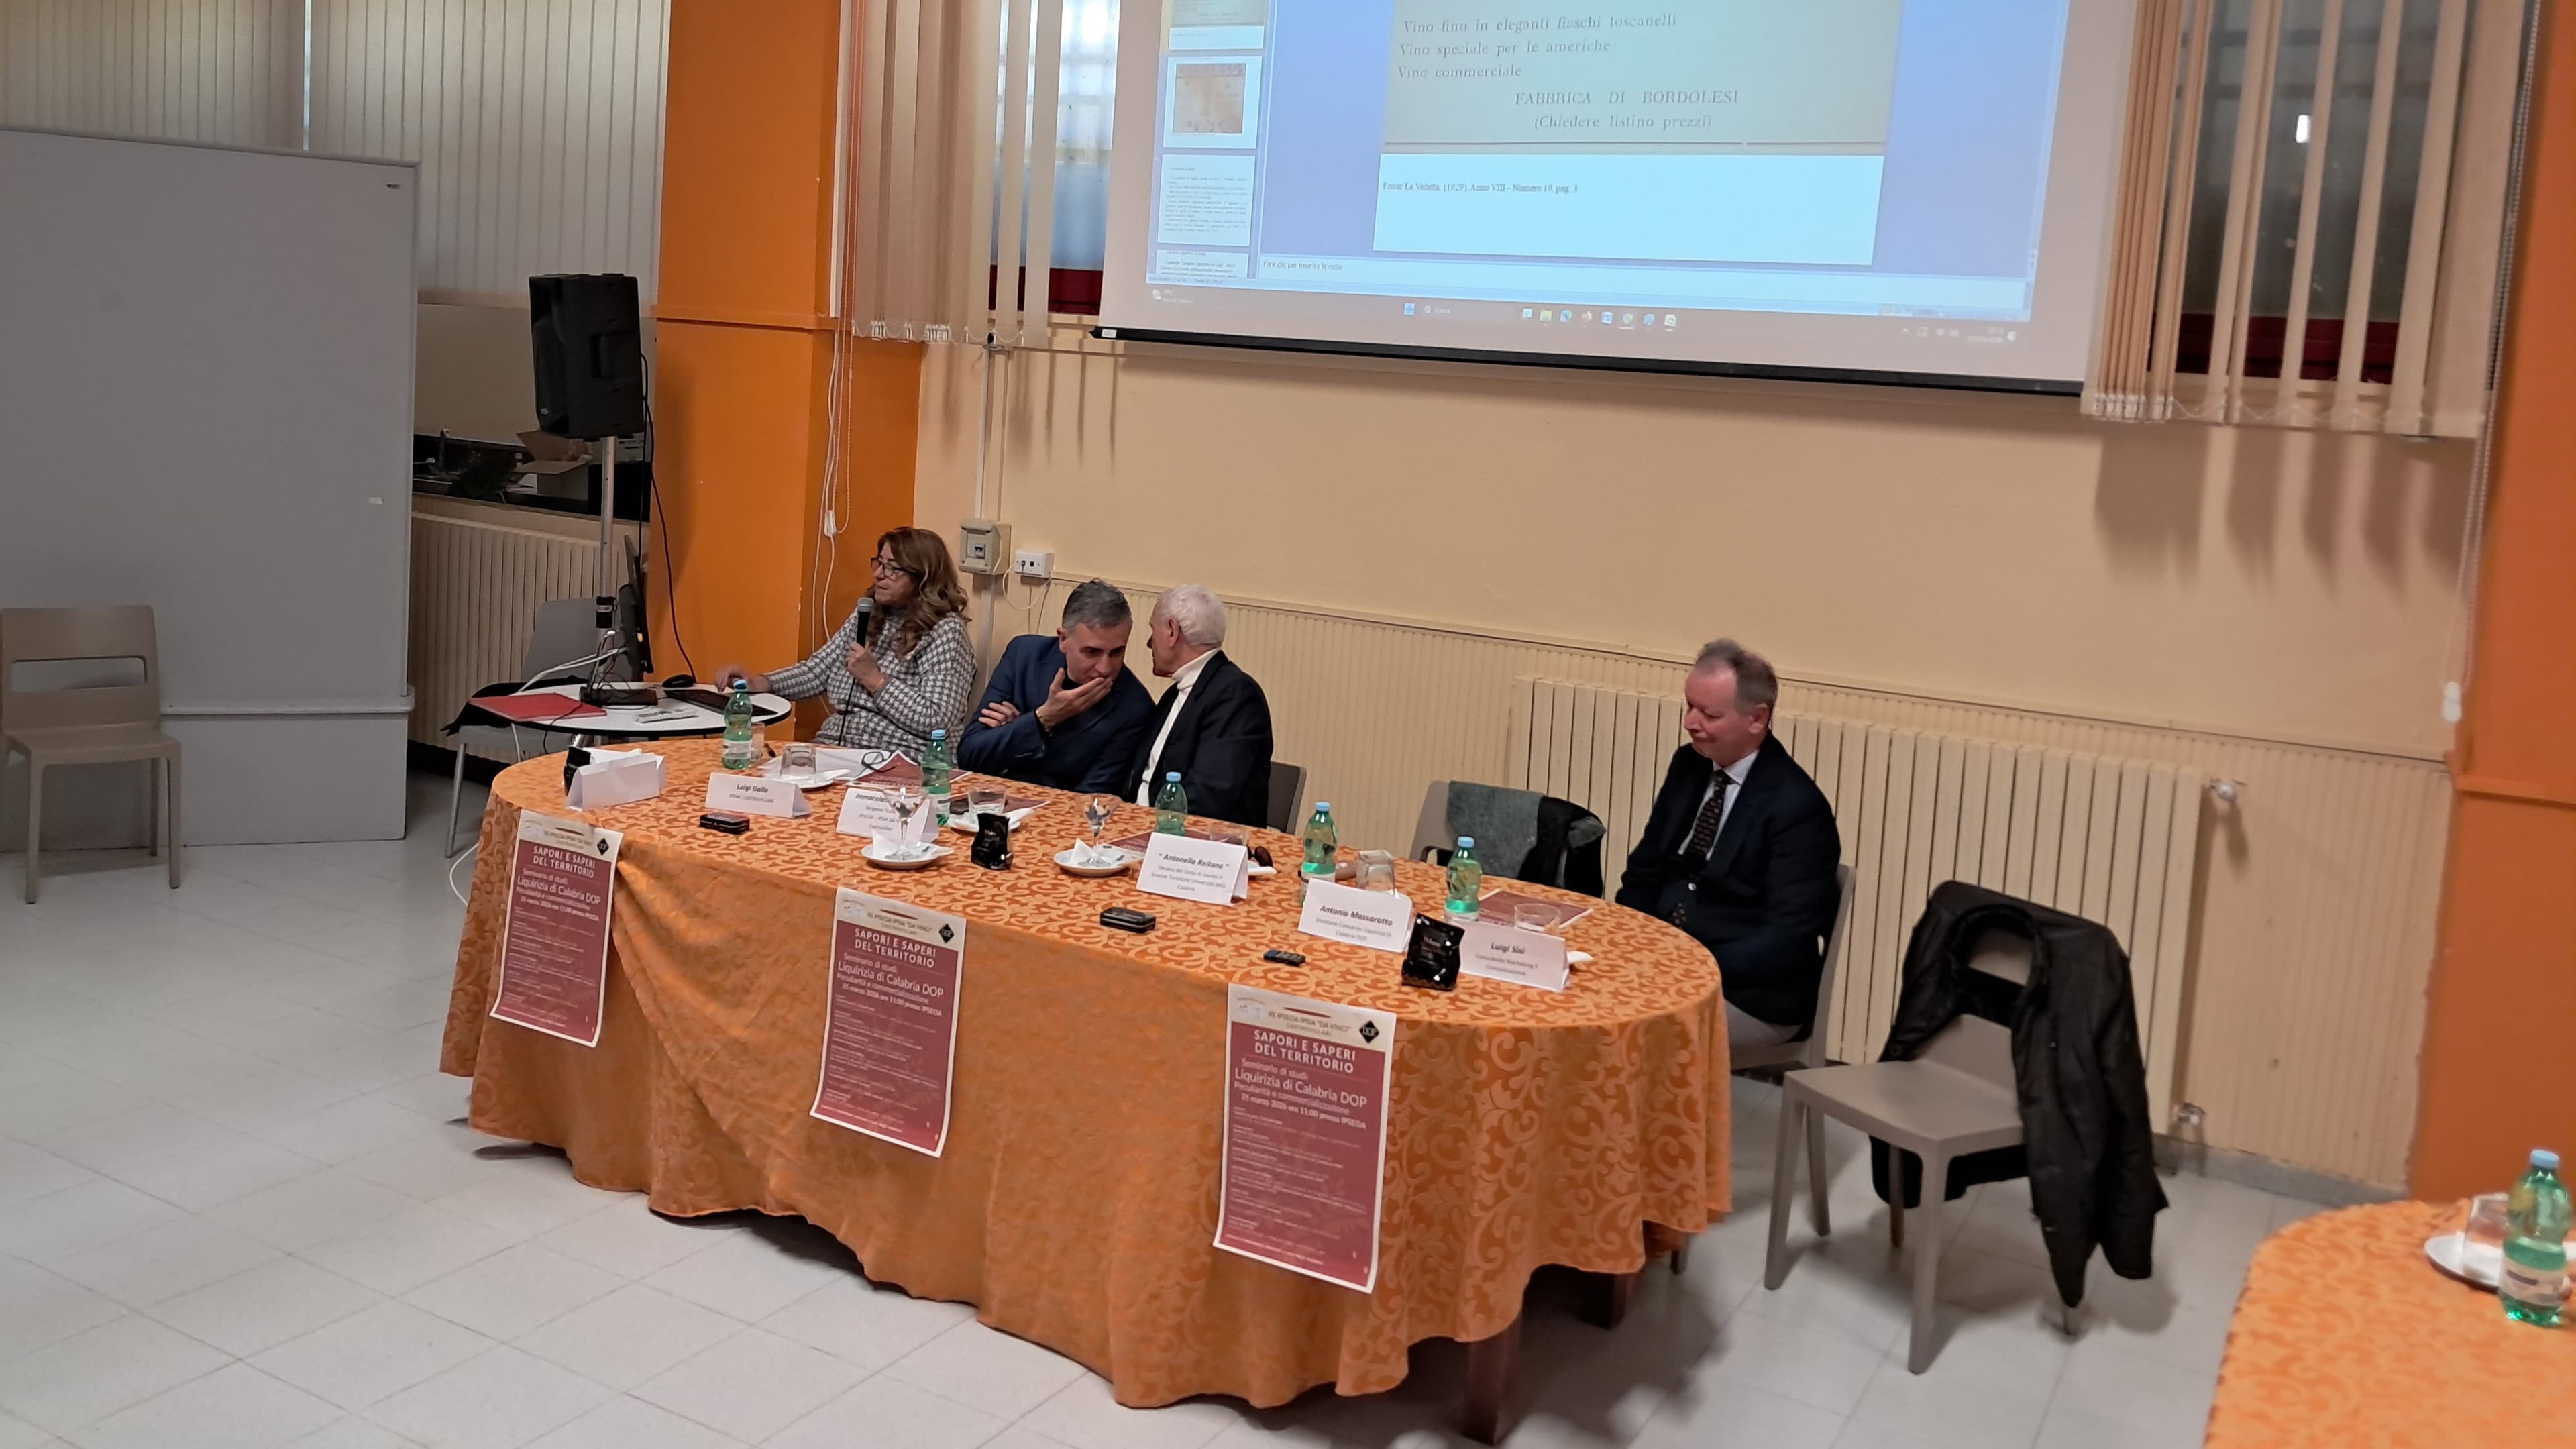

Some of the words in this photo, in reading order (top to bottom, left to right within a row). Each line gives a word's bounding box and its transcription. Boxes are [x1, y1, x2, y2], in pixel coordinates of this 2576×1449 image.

[1403, 19, 1434, 34] Vino
[1440, 19, 1468, 32] fino
[1475, 18, 1488, 32] in
[1497, 16, 1549, 35] eleganti
[1557, 15, 1601, 31] fiaschi
[1609, 14, 1677, 29] toscanelli
[1399, 42, 1430, 56] Vino
[1437, 40, 1489, 58] speciale
[1497, 43, 1519, 57] per
[1526, 40, 1538, 54] le
[1546, 39, 1610, 54] americhe
[1435, 64, 1522, 79] commerciale
[1514, 91, 1592, 106] FABBRICA
[1609, 91, 1625, 105] DI
[1642, 89, 1739, 105] BORDOLESI
[1534, 114, 1600, 130] (Chiedere
[1609, 115, 1654, 129] listino
[1662, 115, 1712, 131] prezzi)
[1492, 183, 1505, 192] VIII
[737, 783, 752, 792] Luigi
[752, 785, 769, 793] Gallo
[533, 845, 563, 860] SAPORI
[566, 853, 570, 862] E
[572, 854, 595, 869] SAPERI
[533, 856, 548, 867] DEL
[550, 859, 594, 879] TERRITORIO
[1163, 853, 1196, 865] Antonella
[1197, 859, 1224, 869] Reitano
[549, 883, 557, 893] di
[557, 885, 585, 900] Calabria
[586, 893, 601, 905] DOP
[1320, 904, 1349, 917] Antonio
[1350, 910, 1393, 926] Massarotto
[854, 928, 890, 947] SAPORI
[893, 937, 899, 949] E
[901, 940, 936, 958] SAPERI
[855, 939, 873, 952] DEL
[875, 944, 935, 968] TERRITORIO
[1491, 941, 1510, 953] Luigi
[838, 961, 875, 980] Liquirizia
[876, 971, 885, 981] di
[886, 974, 920, 993] Calabria
[922, 983, 945, 998] DOP
[1254, 1029, 1297, 1050] SAPORI
[1301, 1039, 1309, 1051] E
[1312, 1041, 1356, 1061] SAPERI
[1254, 1042, 1277, 1057] DEL
[1280, 1046, 1354, 1074] TERRITORIO
[1234, 1067, 1280, 1089] Liquirizia
[1283, 1079, 1293, 1091] di
[1295, 1081, 1338, 1102] Calabria
[1340, 1091, 1368, 1108] DOP
